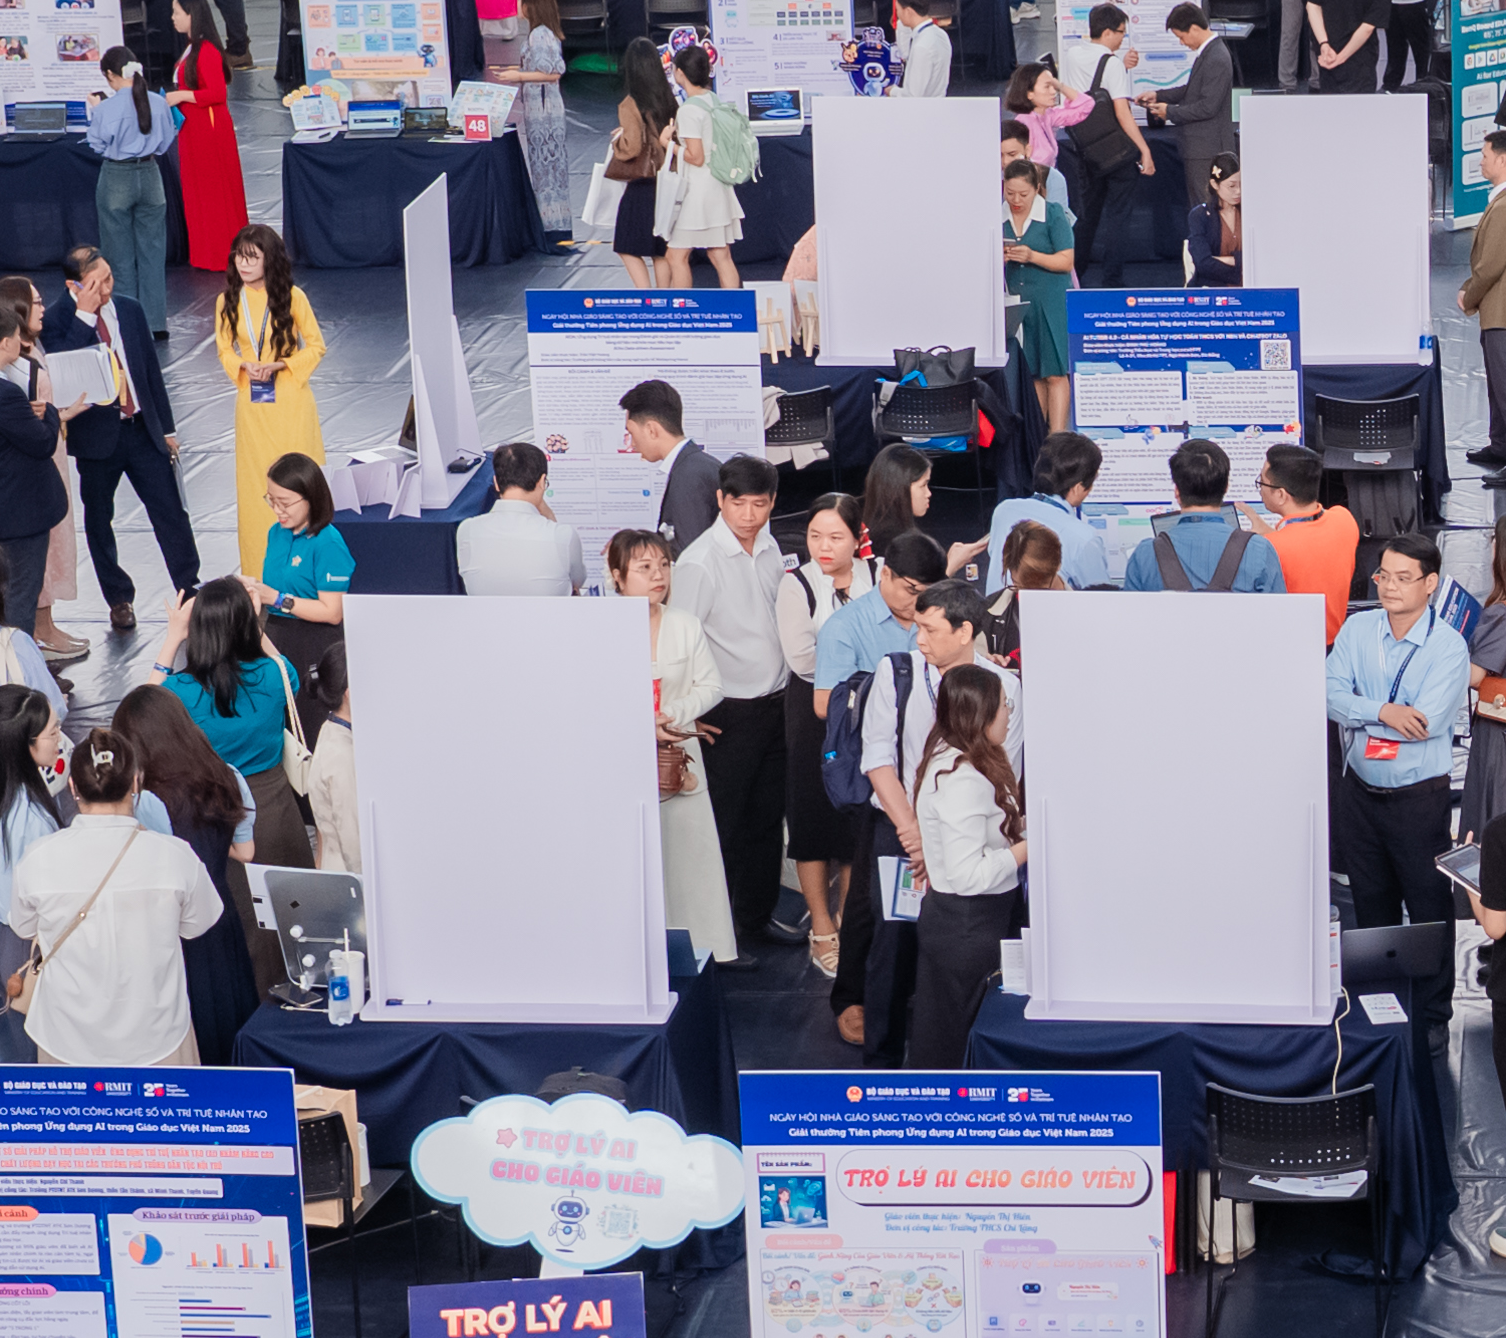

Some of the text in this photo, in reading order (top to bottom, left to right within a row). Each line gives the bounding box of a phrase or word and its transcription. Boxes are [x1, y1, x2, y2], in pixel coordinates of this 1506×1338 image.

[468, 120, 486, 133] 48
[522, 1129, 636, 1160] TRỢ LÝ AI
[491, 1161, 663, 1196] CHO GIÁO VIÊN
[843, 1165, 1136, 1194] TRỢ LÝ AI CHO GIÁO VIÊN
[525, 1295, 567, 1334] LÝ
[573, 1299, 613, 1331] AI
